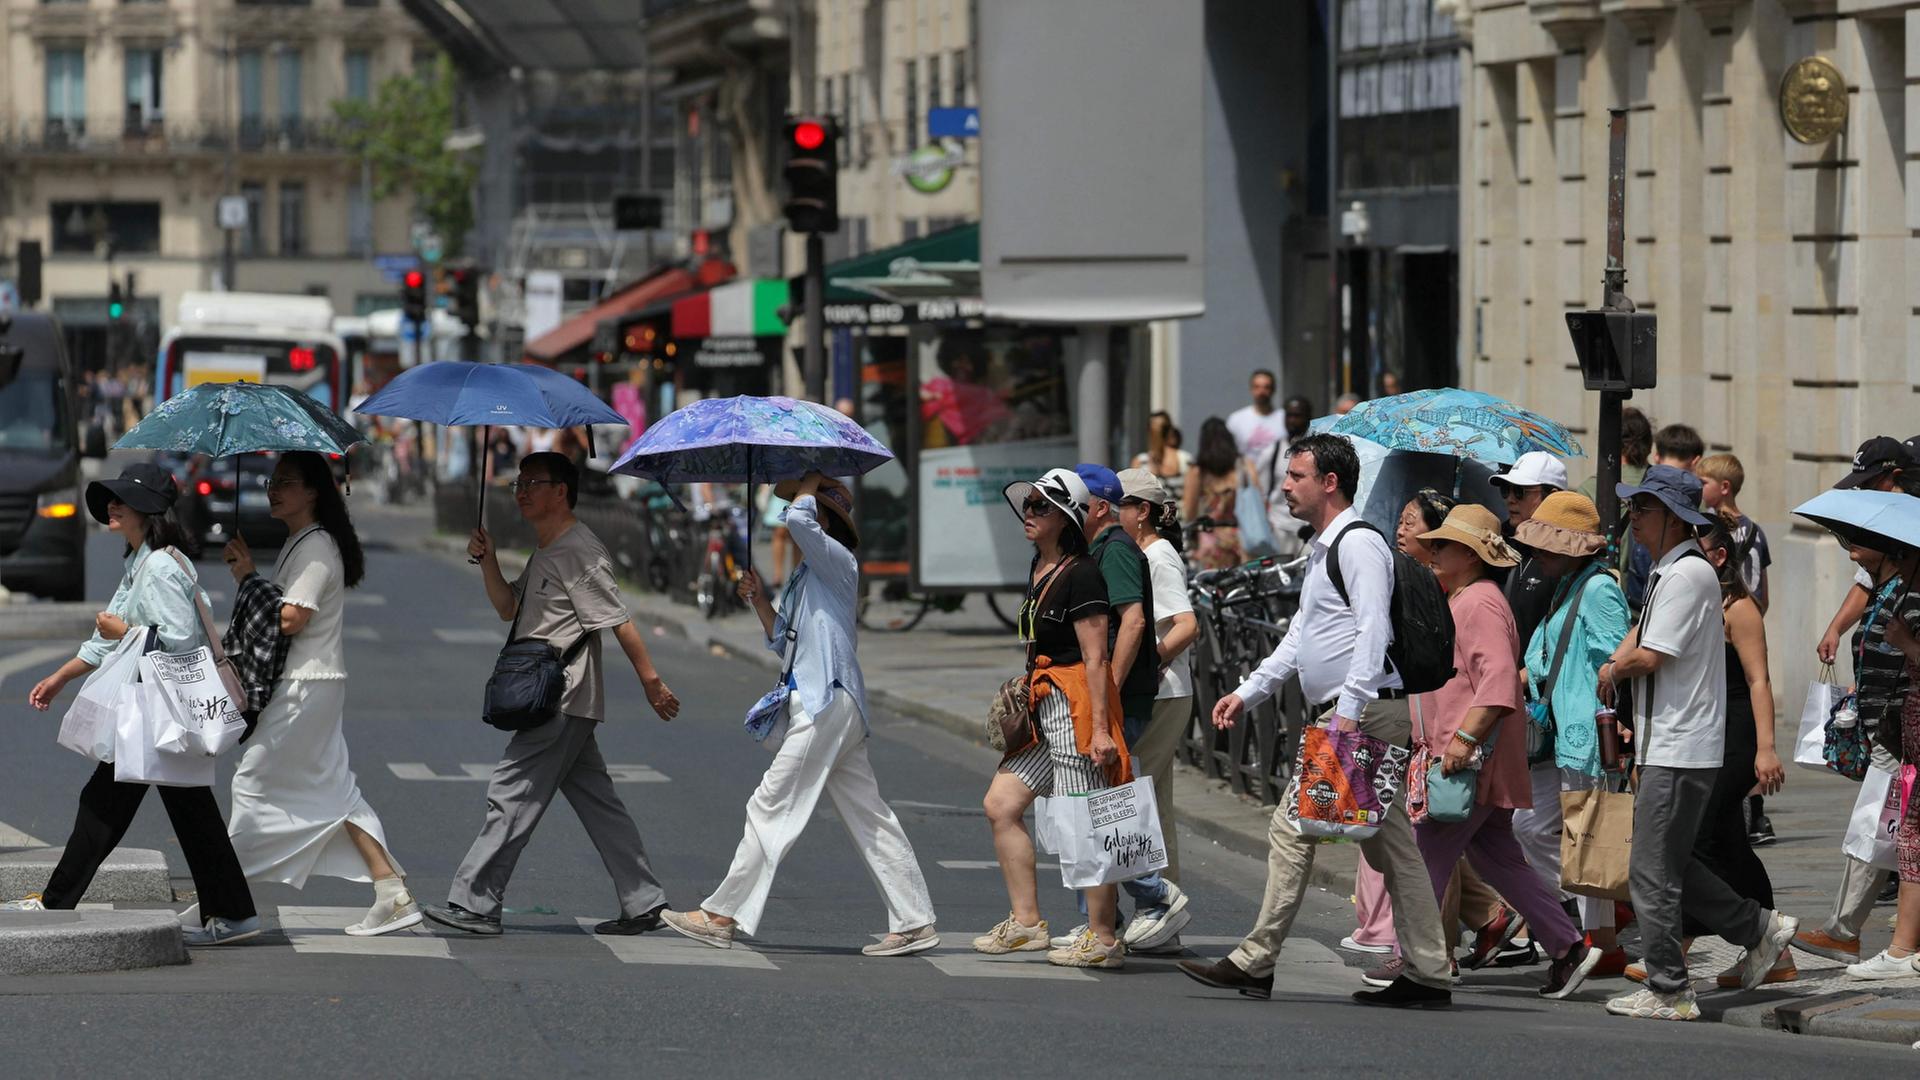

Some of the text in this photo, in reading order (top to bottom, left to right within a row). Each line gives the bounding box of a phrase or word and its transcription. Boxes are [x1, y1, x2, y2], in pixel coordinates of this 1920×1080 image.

[823, 304, 868, 323] 100%
[869, 303, 904, 322] BIO
[1089, 789, 1133, 808] THE DEPARTMENT
[1091, 800, 1124, 816] STORE THAT
[1094, 807, 1135, 826] NEVER SLEEPS
